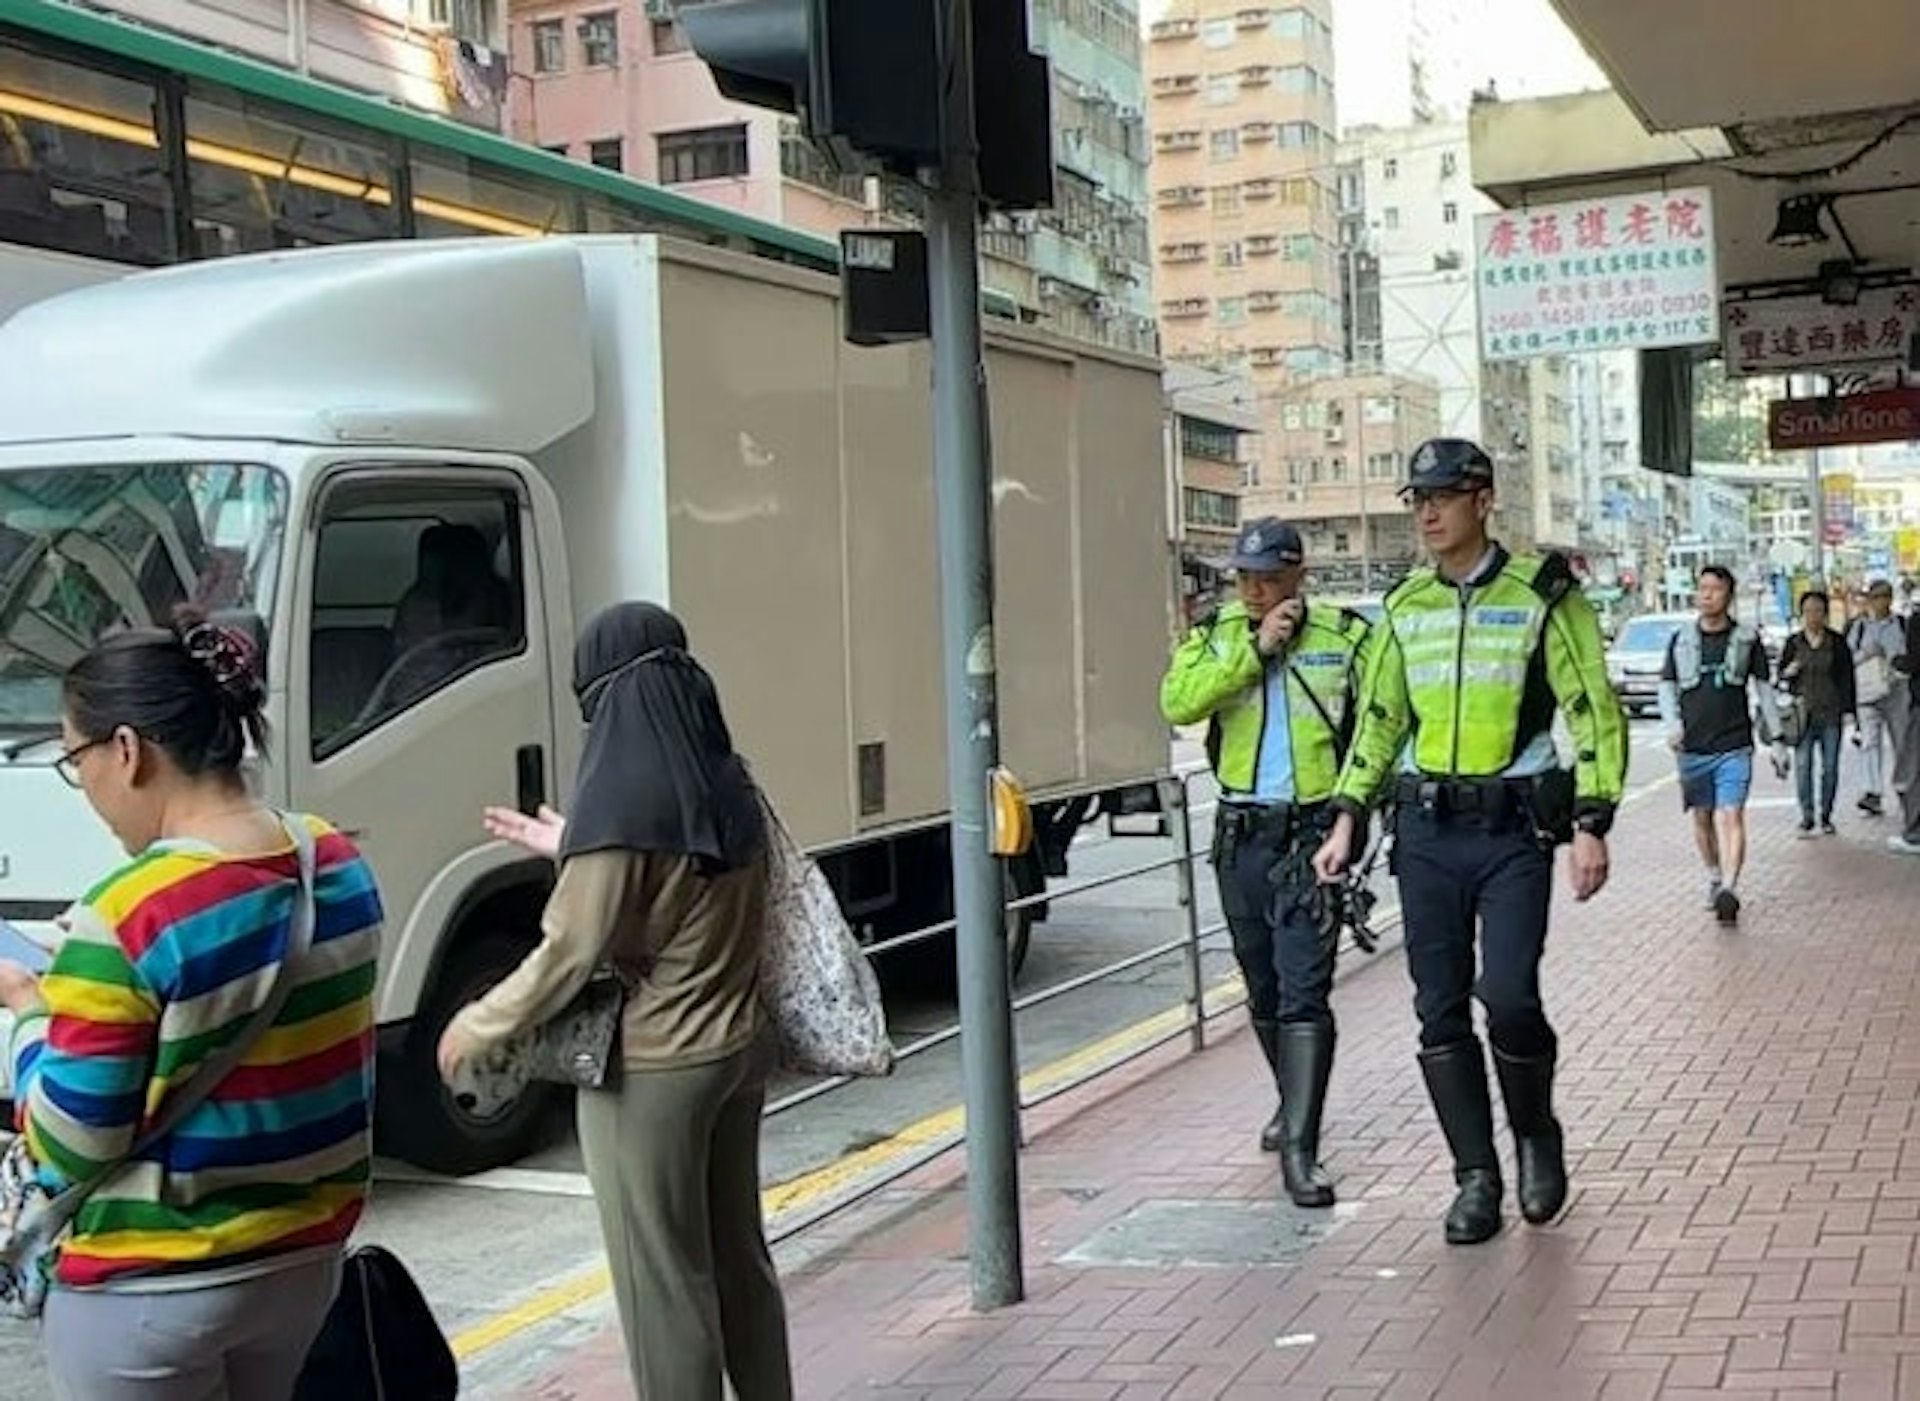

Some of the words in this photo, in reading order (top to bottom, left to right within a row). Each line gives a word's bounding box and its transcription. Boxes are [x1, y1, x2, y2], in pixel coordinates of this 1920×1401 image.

[1484, 200, 1705, 259] 康福護老院
